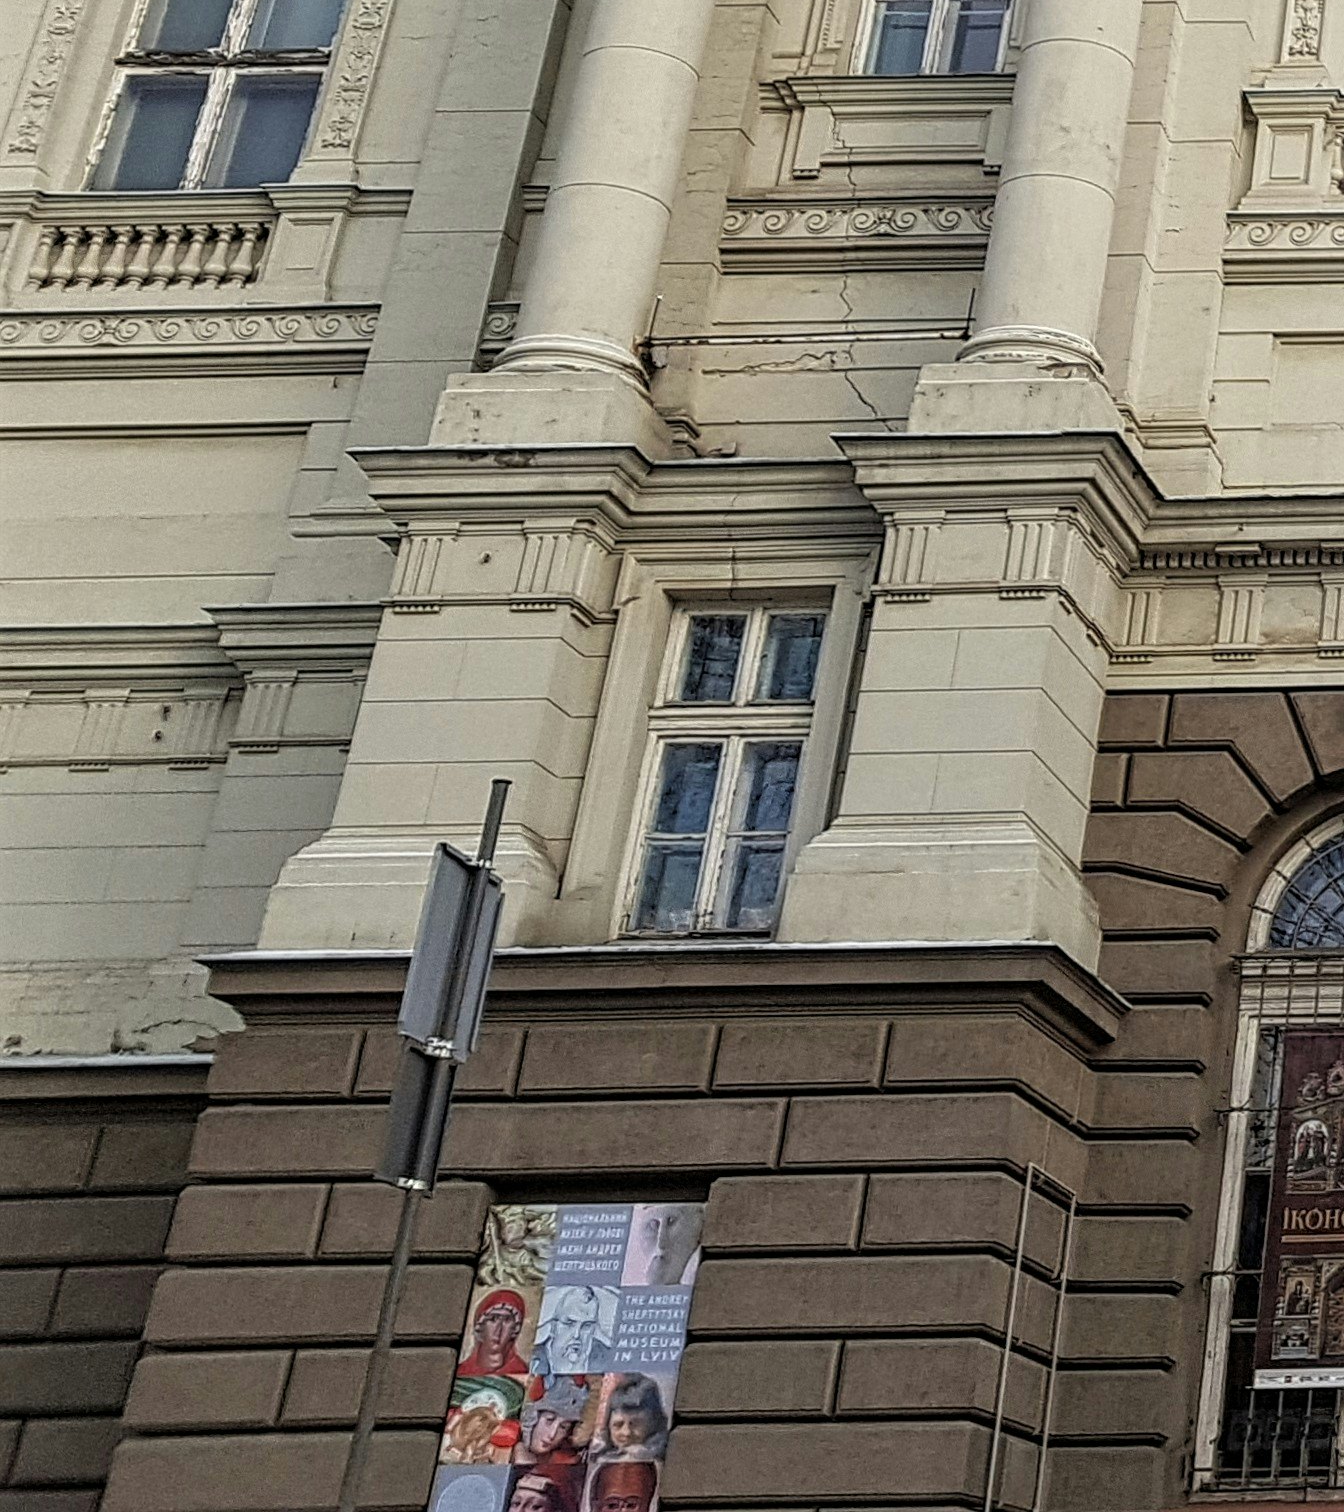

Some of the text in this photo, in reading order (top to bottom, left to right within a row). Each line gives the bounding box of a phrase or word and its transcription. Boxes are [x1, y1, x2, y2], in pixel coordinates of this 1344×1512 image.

[625, 1294, 689, 1305] THE ANDREY
[622, 1309, 686, 1320] SHEPTYTSKY
[618, 1323, 682, 1334] NATIONAL
[616, 1337, 680, 1348] MUSEUM
[613, 1350, 680, 1361] IN LVIV
